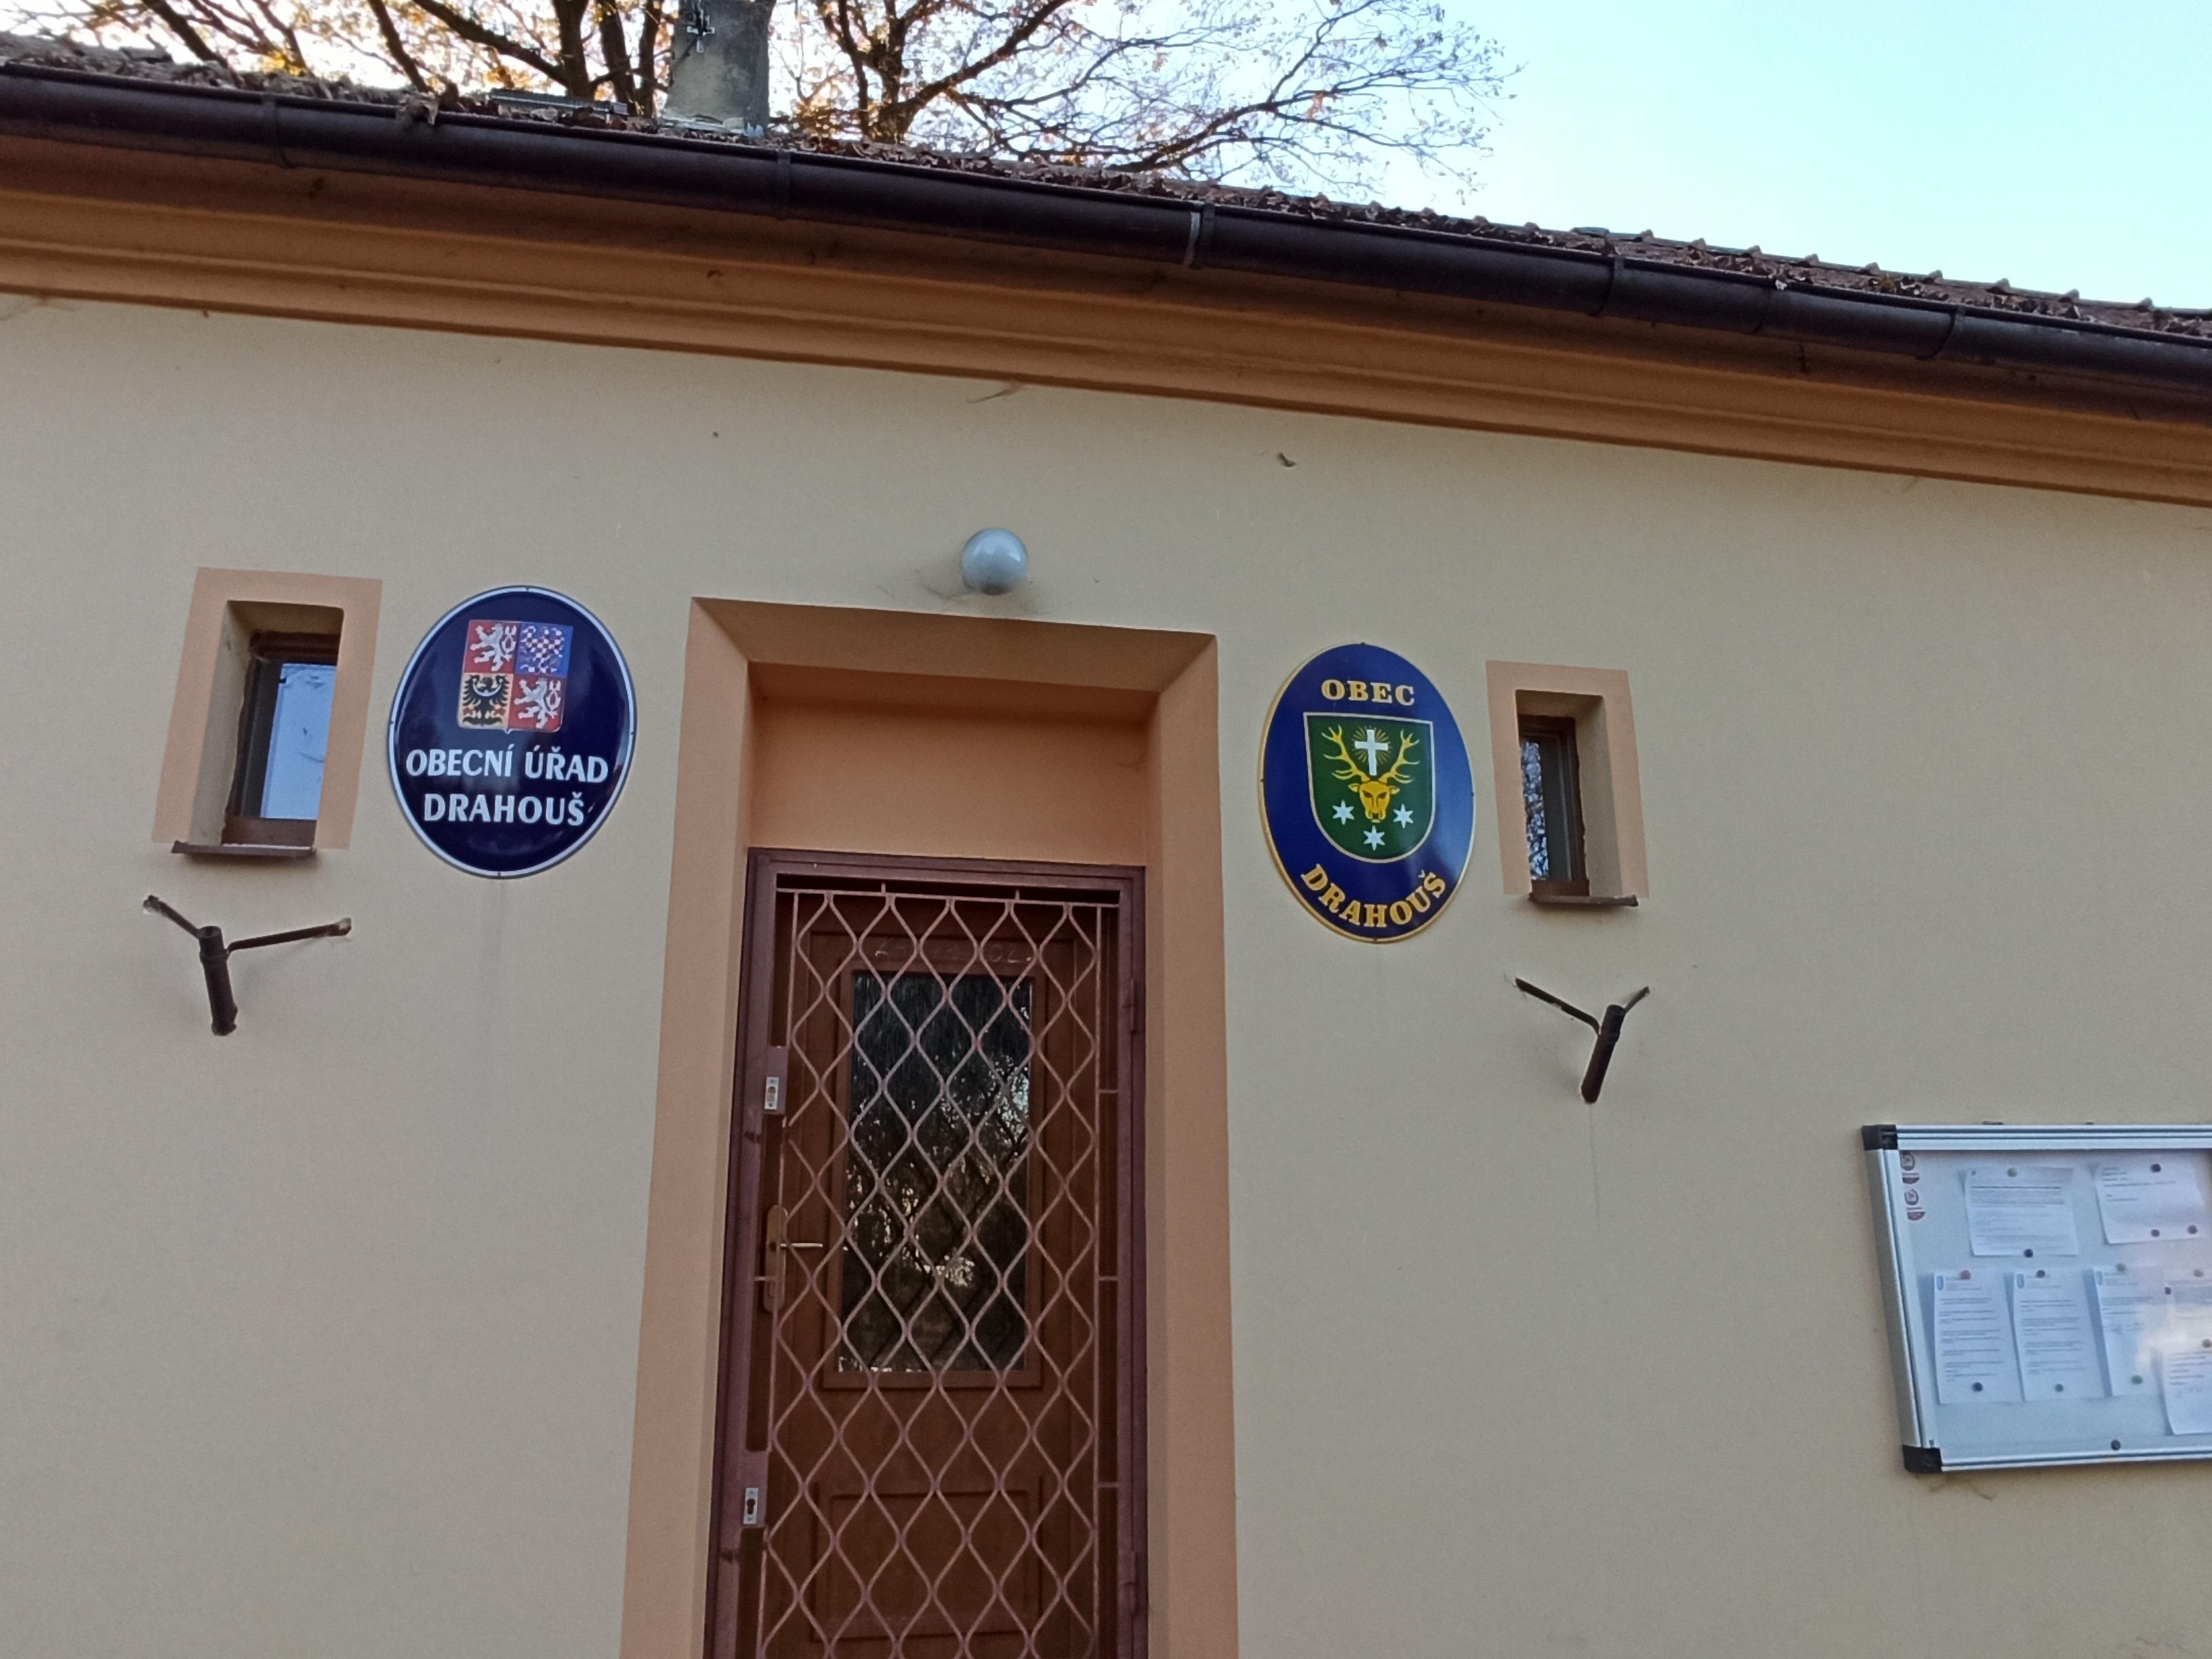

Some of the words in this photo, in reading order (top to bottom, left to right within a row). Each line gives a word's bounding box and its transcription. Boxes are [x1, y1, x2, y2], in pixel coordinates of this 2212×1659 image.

[1321, 679, 1415, 706] OBEC
[406, 743, 514, 777] OBECNÍ
[525, 745, 609, 783] ÚŘAD
[424, 792, 585, 827] DRAHOUŠ
[1300, 863, 1446, 928] DRAHOUŠ
